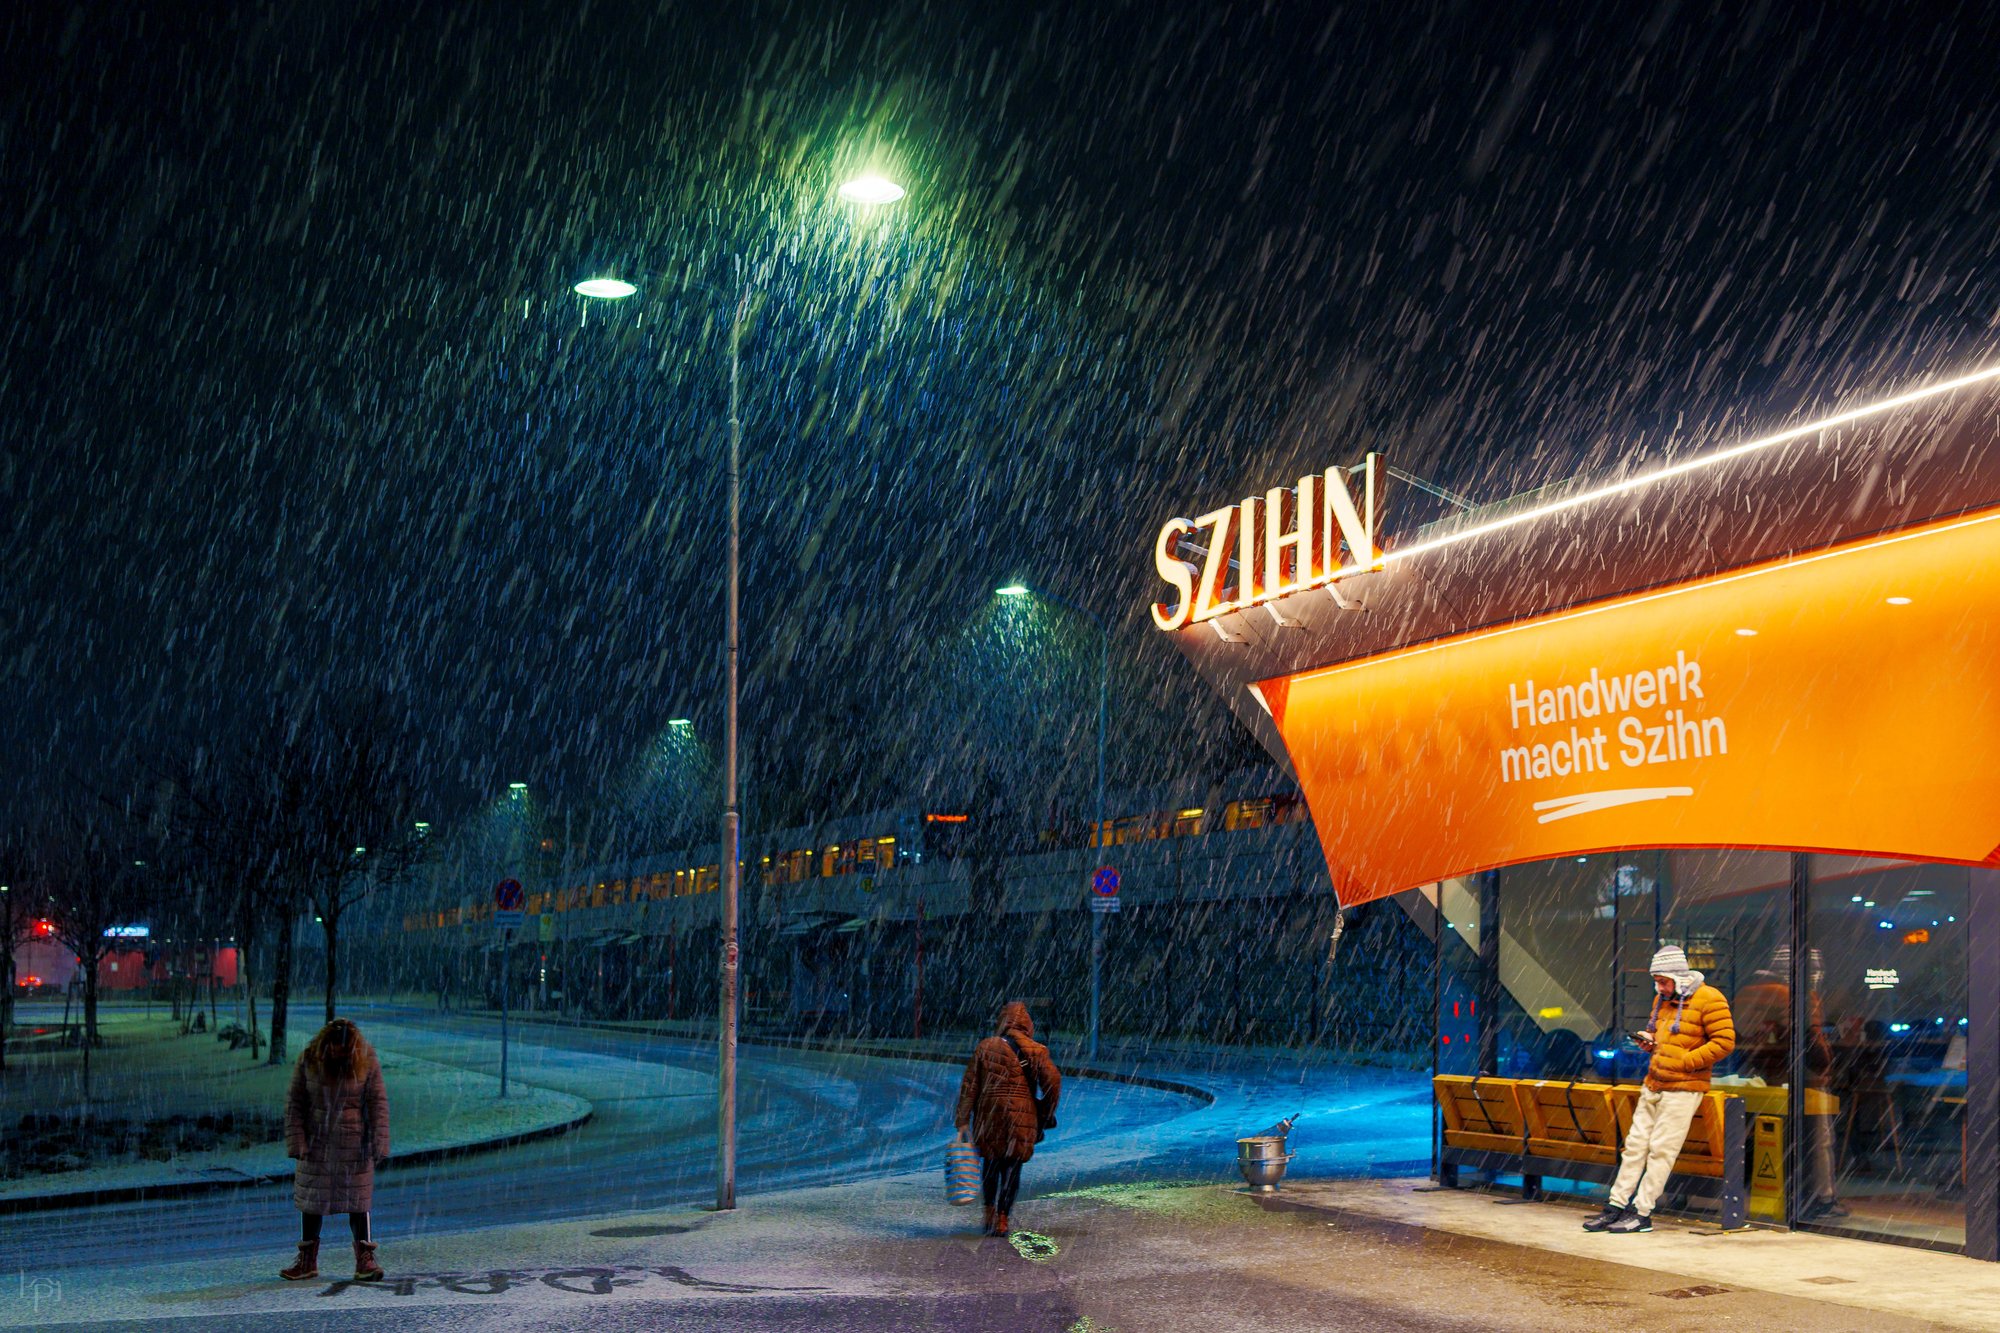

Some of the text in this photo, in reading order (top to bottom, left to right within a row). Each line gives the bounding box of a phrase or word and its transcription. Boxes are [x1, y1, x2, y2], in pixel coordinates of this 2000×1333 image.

[1151, 452, 1384, 631] SZIHN
[1509, 650, 1704, 729] Handwerk
[1501, 709, 1728, 782] macht Szihn
